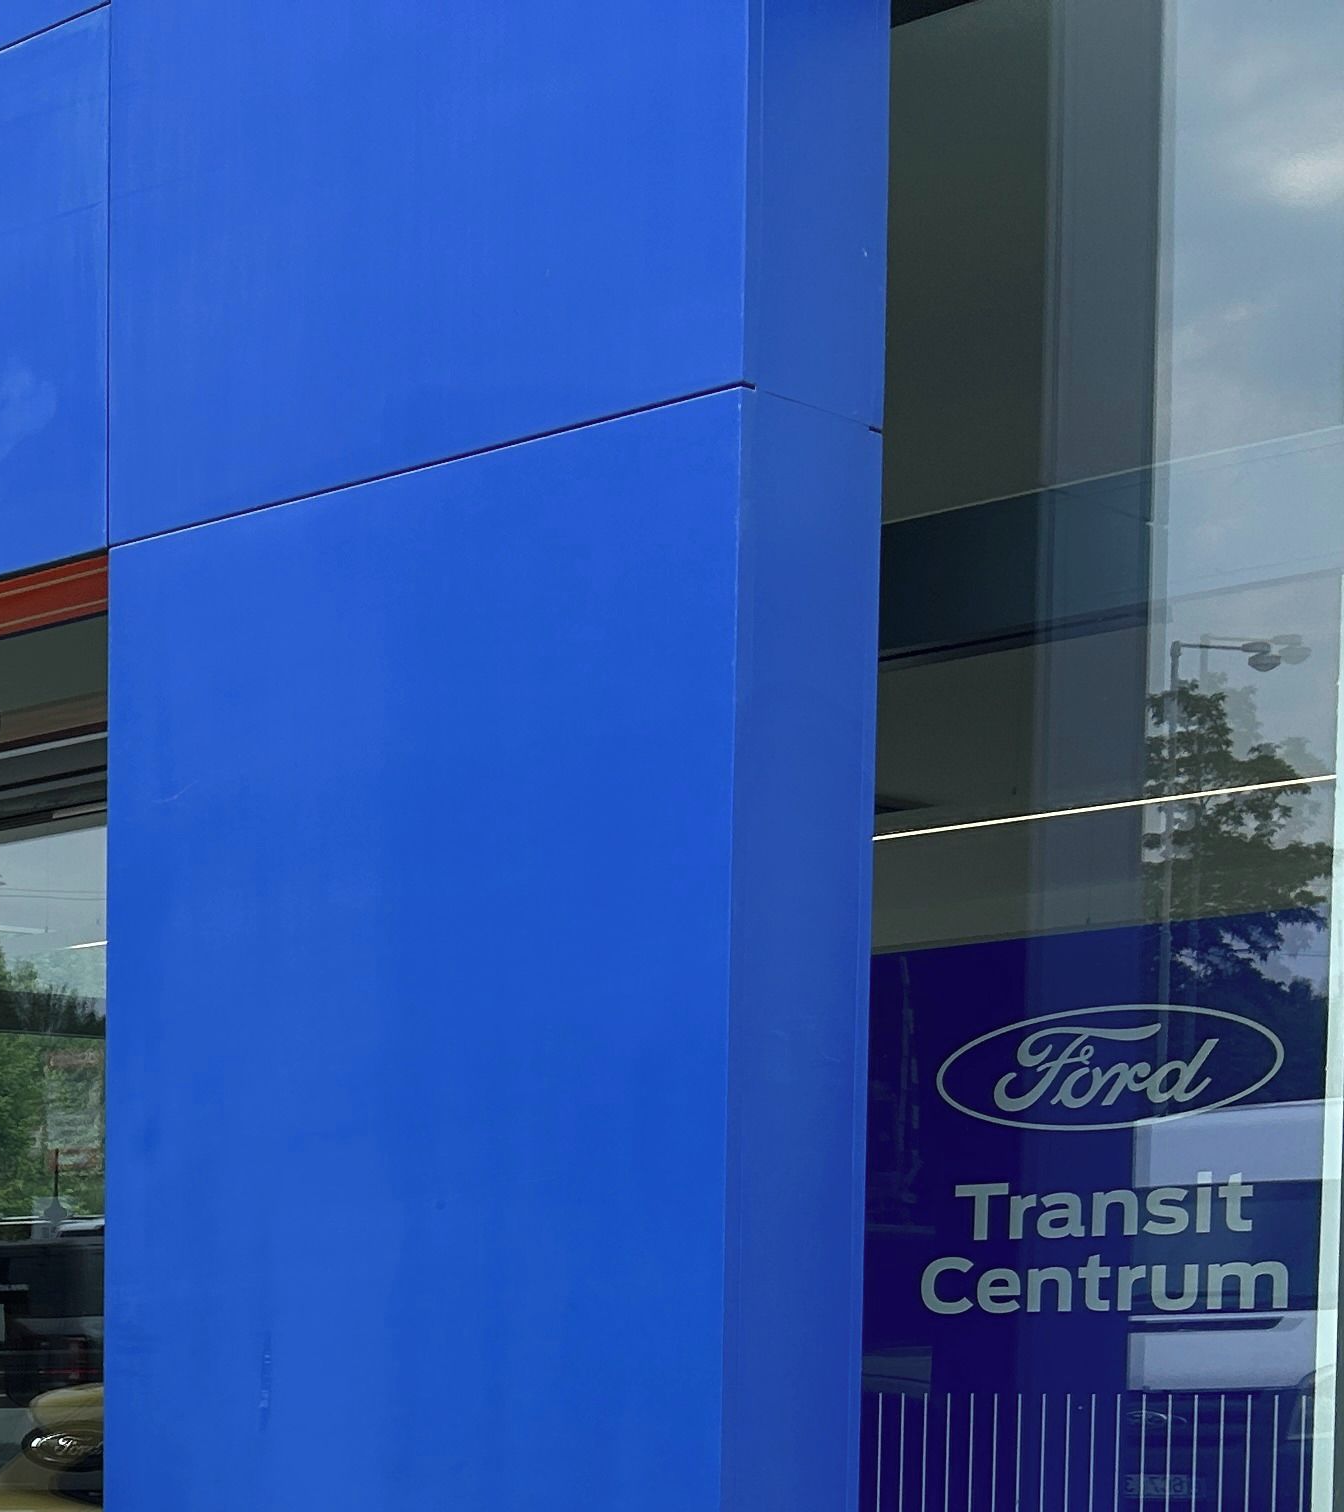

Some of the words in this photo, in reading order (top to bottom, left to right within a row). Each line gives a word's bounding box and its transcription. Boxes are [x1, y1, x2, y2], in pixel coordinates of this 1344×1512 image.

[993, 1022, 1219, 1112] Ford
[955, 1171, 1254, 1241] Transit
[921, 1254, 1289, 1315] Centrum
